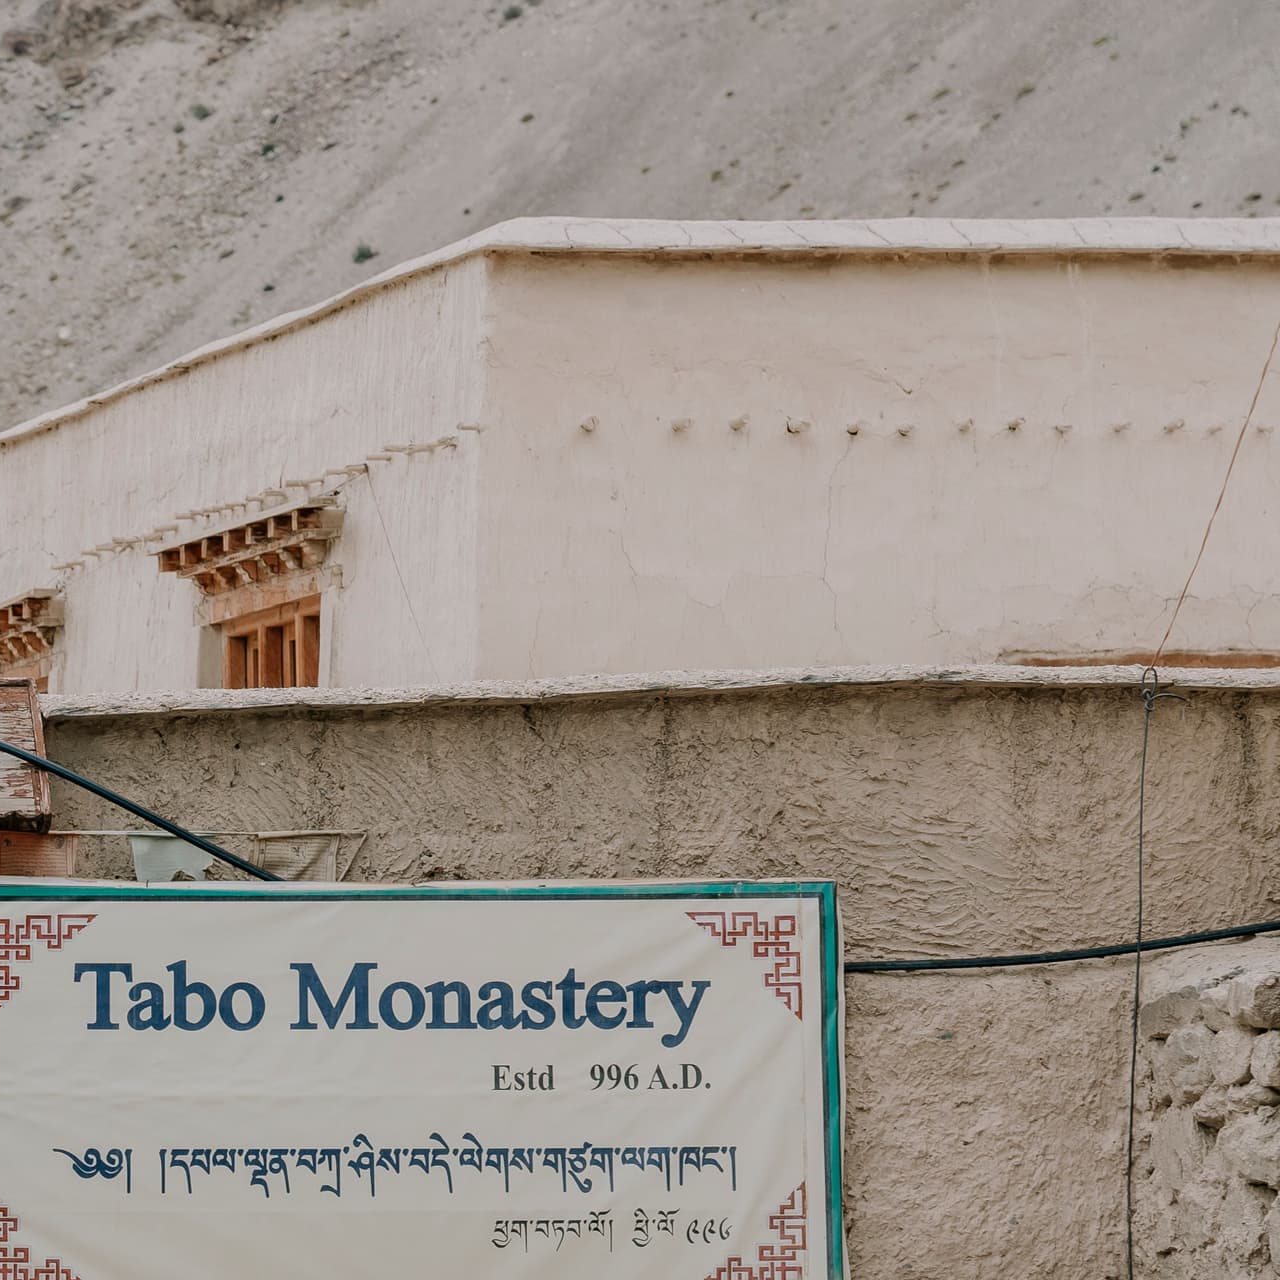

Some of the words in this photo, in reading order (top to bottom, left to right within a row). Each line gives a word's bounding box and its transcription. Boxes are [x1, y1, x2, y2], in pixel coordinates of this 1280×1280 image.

[74, 960, 265, 1031] Tabo
[290, 963, 711, 1048] Monastery
[492, 1065, 554, 1090] Estd
[590, 1064, 638, 1090] 996
[648, 1064, 710, 1089] A.D.
